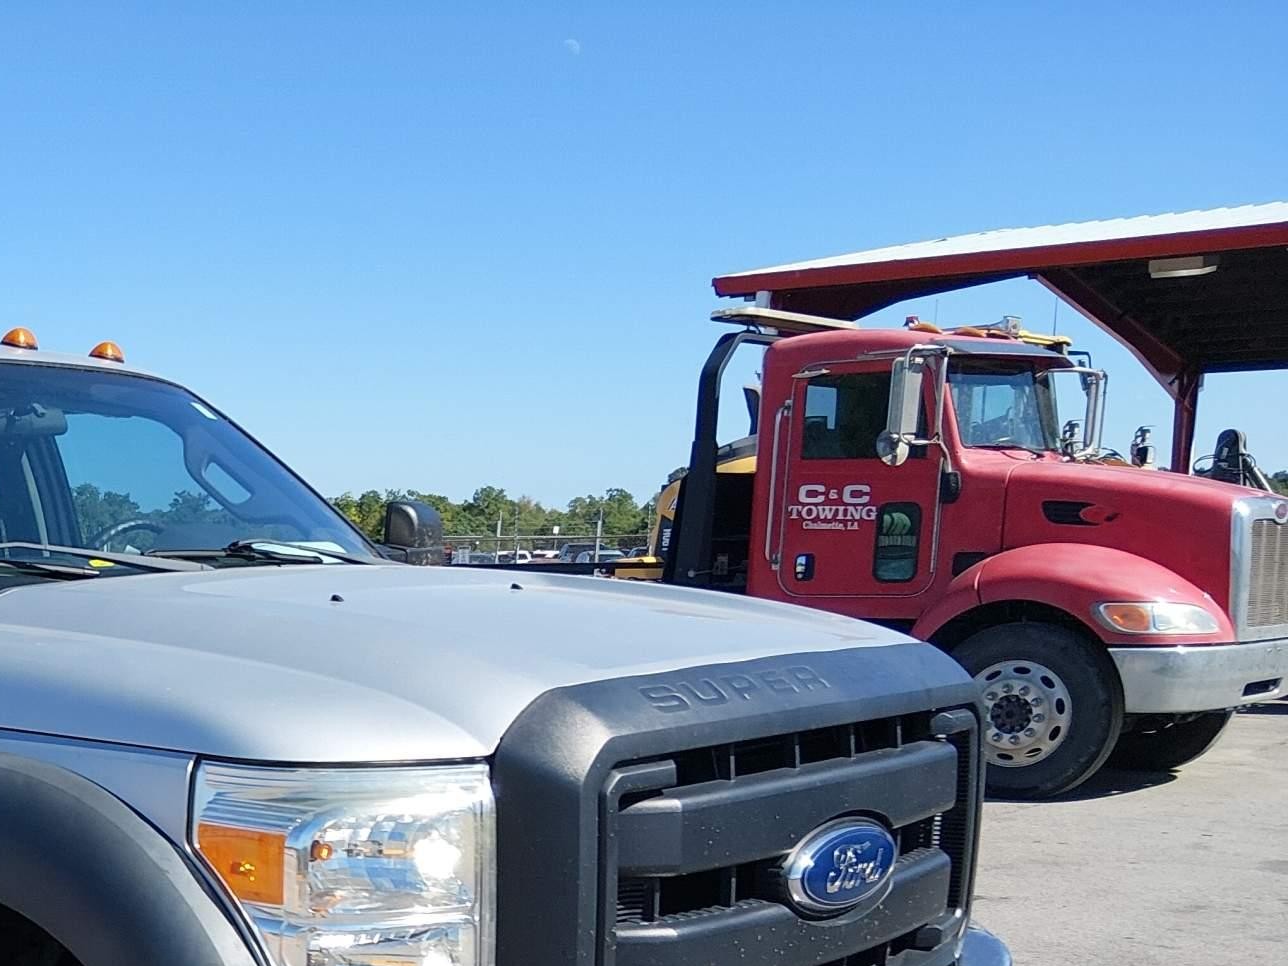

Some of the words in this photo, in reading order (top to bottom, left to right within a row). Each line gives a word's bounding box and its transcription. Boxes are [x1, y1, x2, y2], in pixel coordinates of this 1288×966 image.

[798, 484, 825, 503] C
[828, 489, 839, 499] &
[842, 484, 871, 503] C
[788, 505, 878, 520] TOWING
[847, 521, 859, 530] LA
[638, 664, 832, 713] SUPER
[826, 841, 885, 893] Ford
